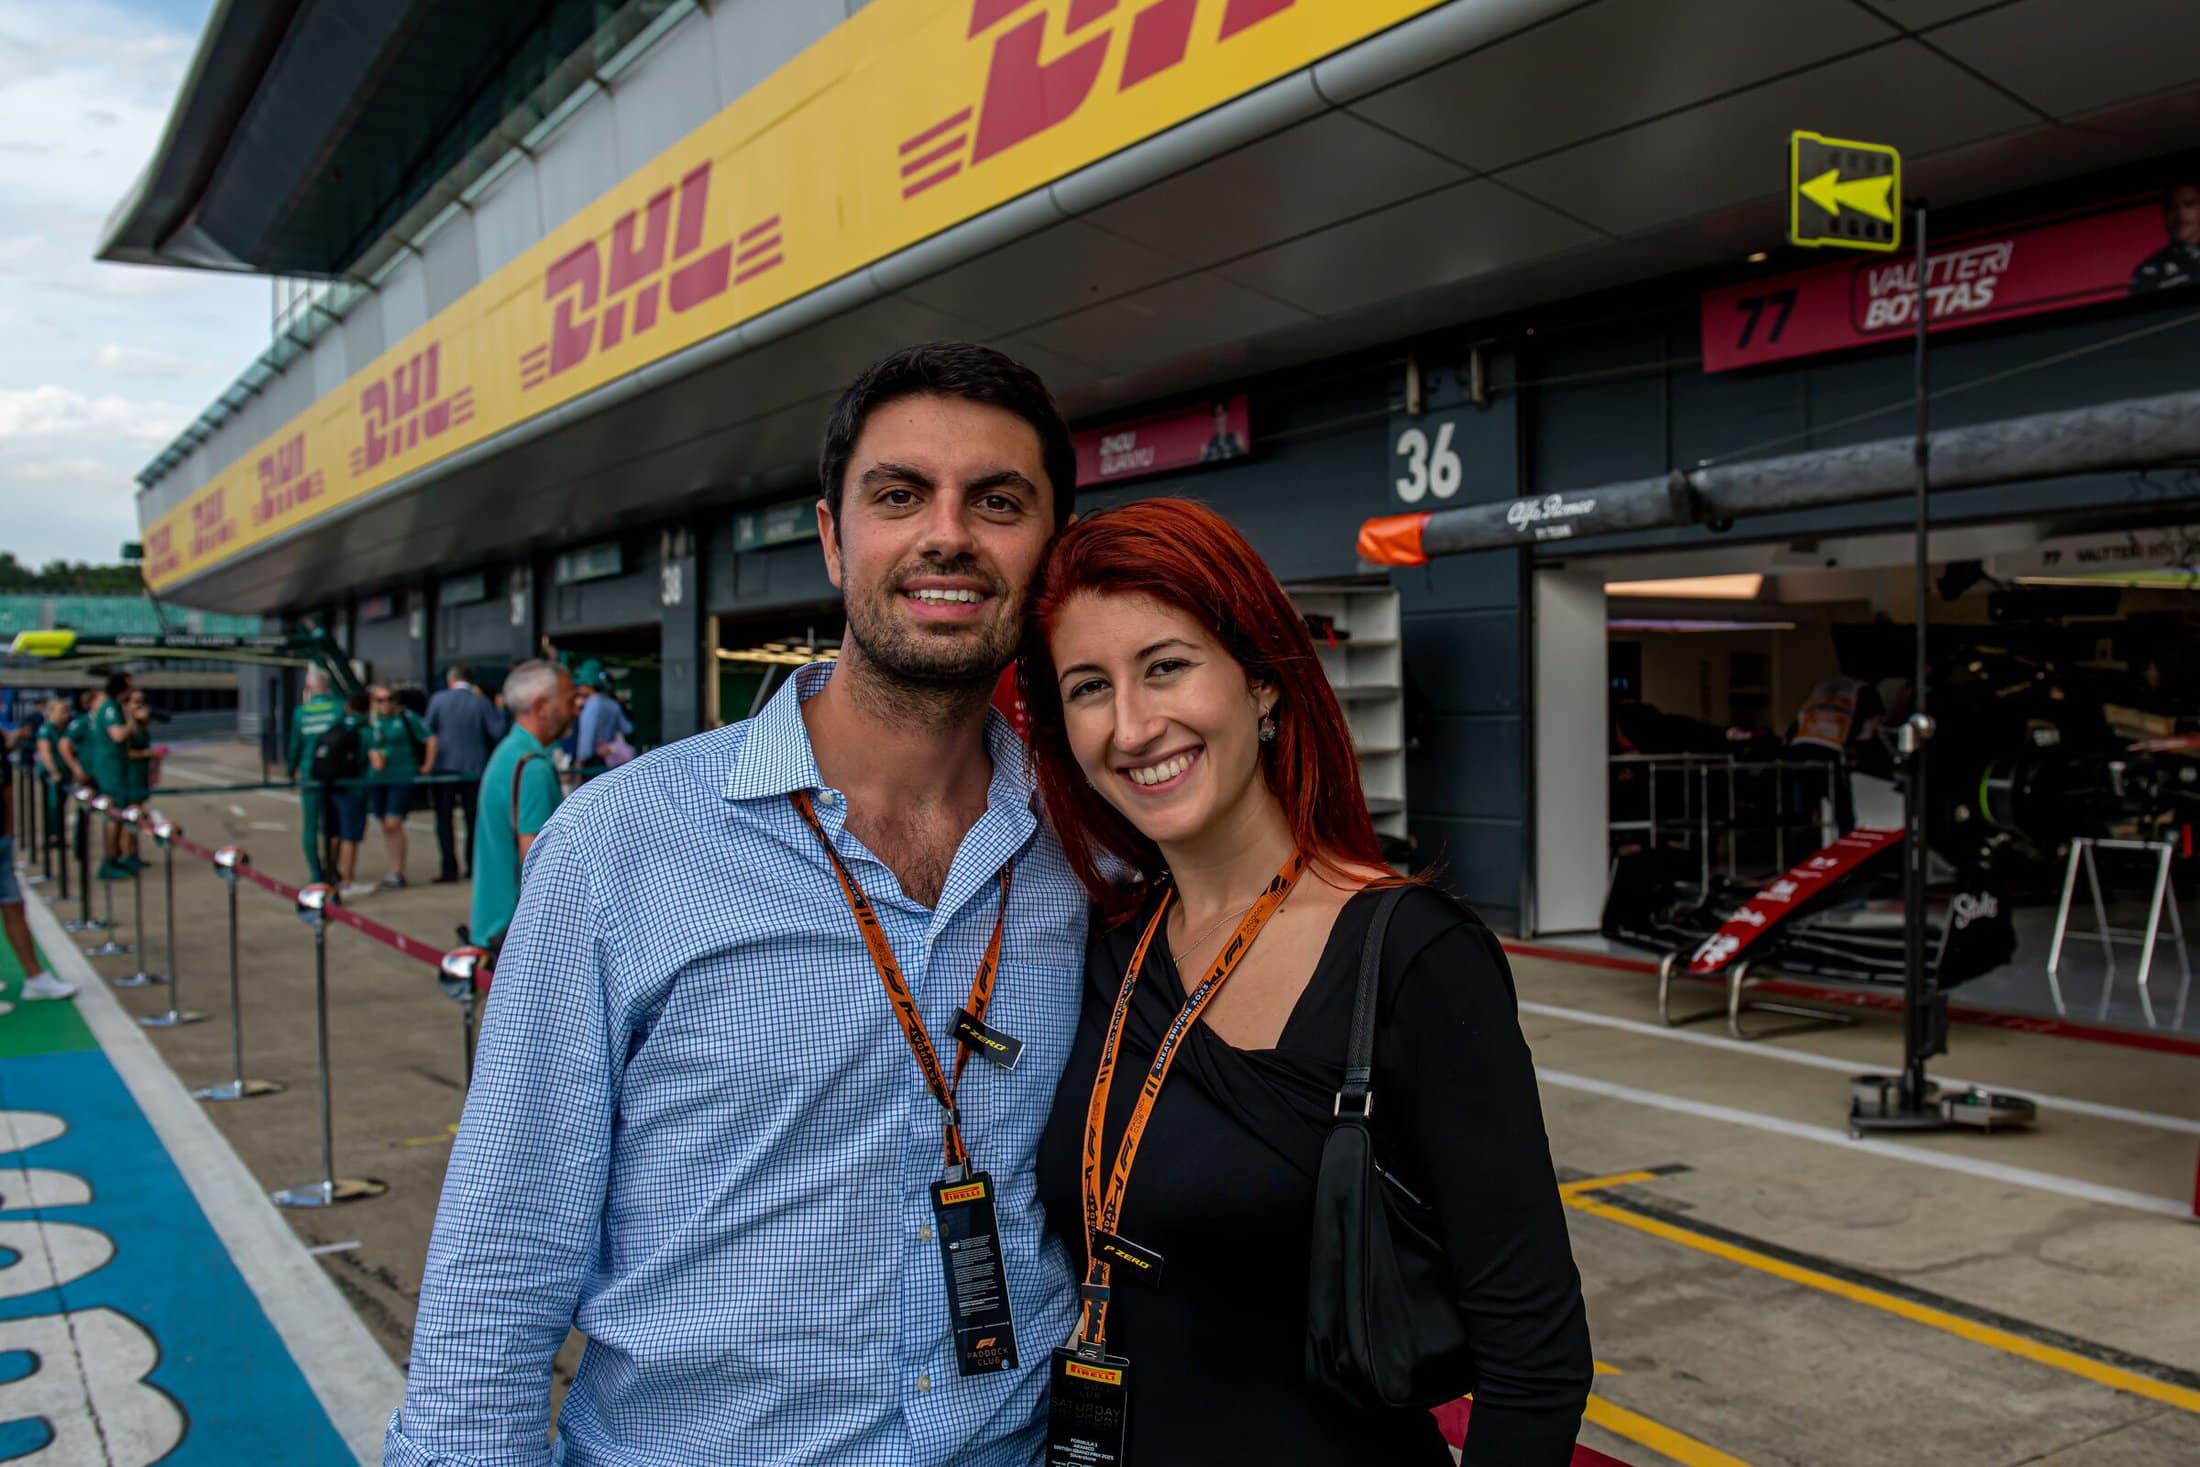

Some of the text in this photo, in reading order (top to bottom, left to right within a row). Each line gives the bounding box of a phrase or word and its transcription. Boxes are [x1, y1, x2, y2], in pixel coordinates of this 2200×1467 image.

[545, 158, 733, 378] DHL
[1736, 288, 1798, 350] 77
[360, 339, 450, 469] DHL
[1395, 423, 1462, 502] 36
[969, 1030, 1007, 1052] ZERO
[1155, 1041, 1172, 1070] GREAT
[1168, 1007, 1192, 1040] BRITAIN
[944, 1185, 980, 1201] PIRELLI
[1114, 1249, 1152, 1270] ZERO
[967, 1346, 1009, 1360] PADDOCK
[1071, 1363, 1117, 1381] PIRELLI
